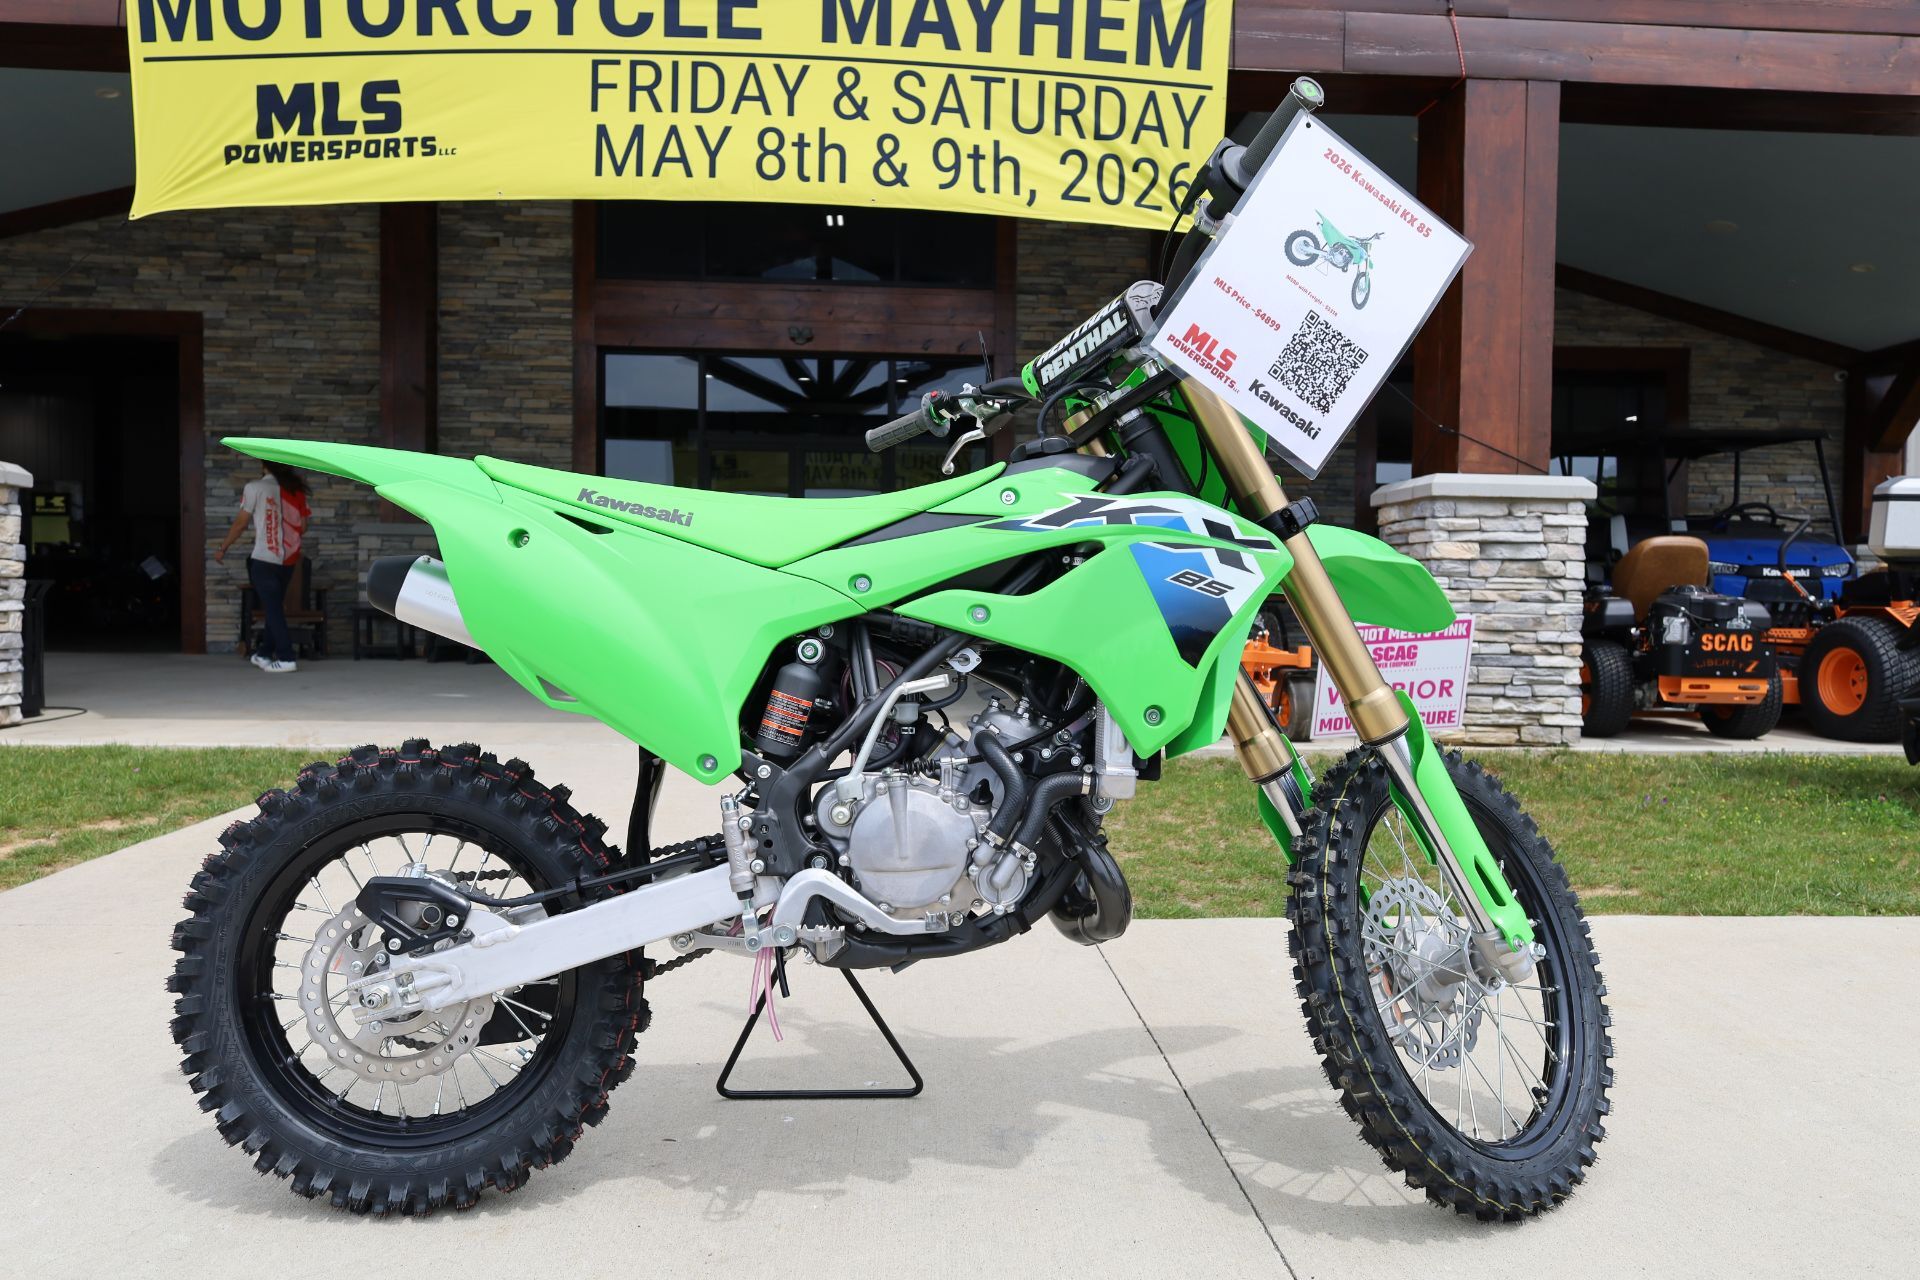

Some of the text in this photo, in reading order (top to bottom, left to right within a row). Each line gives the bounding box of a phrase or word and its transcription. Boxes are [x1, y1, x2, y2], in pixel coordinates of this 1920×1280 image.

[138, 0, 1203, 71] MOTORCYCLE MAYHEM
[255, 79, 402, 140] MLS
[589, 59, 1206, 150] FRIDAY & SATURDAY
[223, 136, 457, 165] POWERSPORTS LLC
[594, 124, 1192, 213] MAY 8th & 9th, 2026
[1323, 148, 1432, 238] 2026 Kawasaki KX 85
[1213, 276, 1232, 294] MLS
[1231, 290, 1251, 309] Price
[1040, 310, 1128, 386] RENTHAL
[1166, 333, 1236, 390] POWERSPORTS
[1182, 322, 1237, 373] MLS
[1248, 378, 1321, 440] Kawasaki
[576, 487, 694, 527] Kawasaki
[1168, 570, 1235, 598] 85
[1372, 644, 1418, 662] SCAG
[1701, 633, 1753, 652] SCAG
